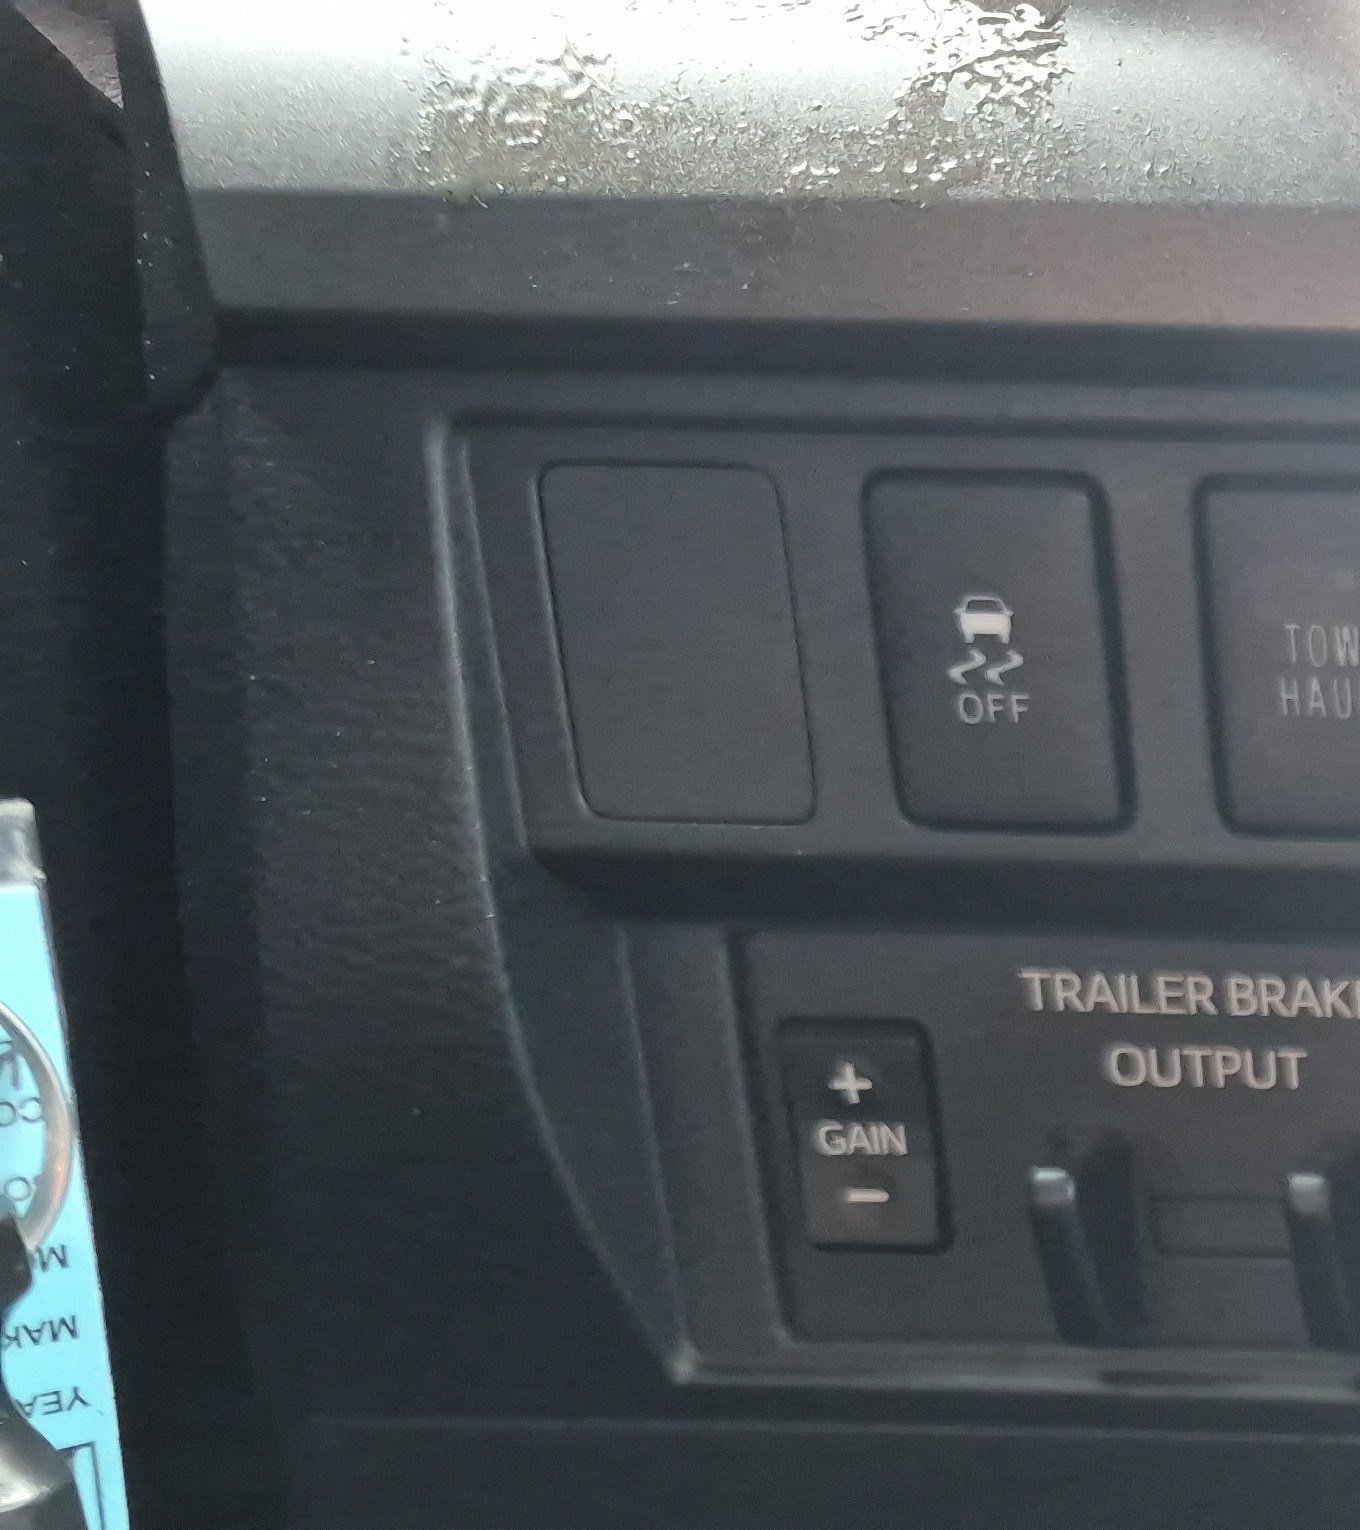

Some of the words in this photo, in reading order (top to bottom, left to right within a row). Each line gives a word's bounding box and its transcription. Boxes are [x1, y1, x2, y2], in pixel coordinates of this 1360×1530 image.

[1283, 622, 1360, 669] TOW
[956, 691, 1030, 725] OFF
[1017, 970, 1219, 1016] TRAILER
[1105, 1045, 1309, 1091] OUTPUT
[815, 1120, 909, 1157] GAIN
[1, 1314, 80, 1350] MAK
[16, 1386, 92, 1419] YEA
